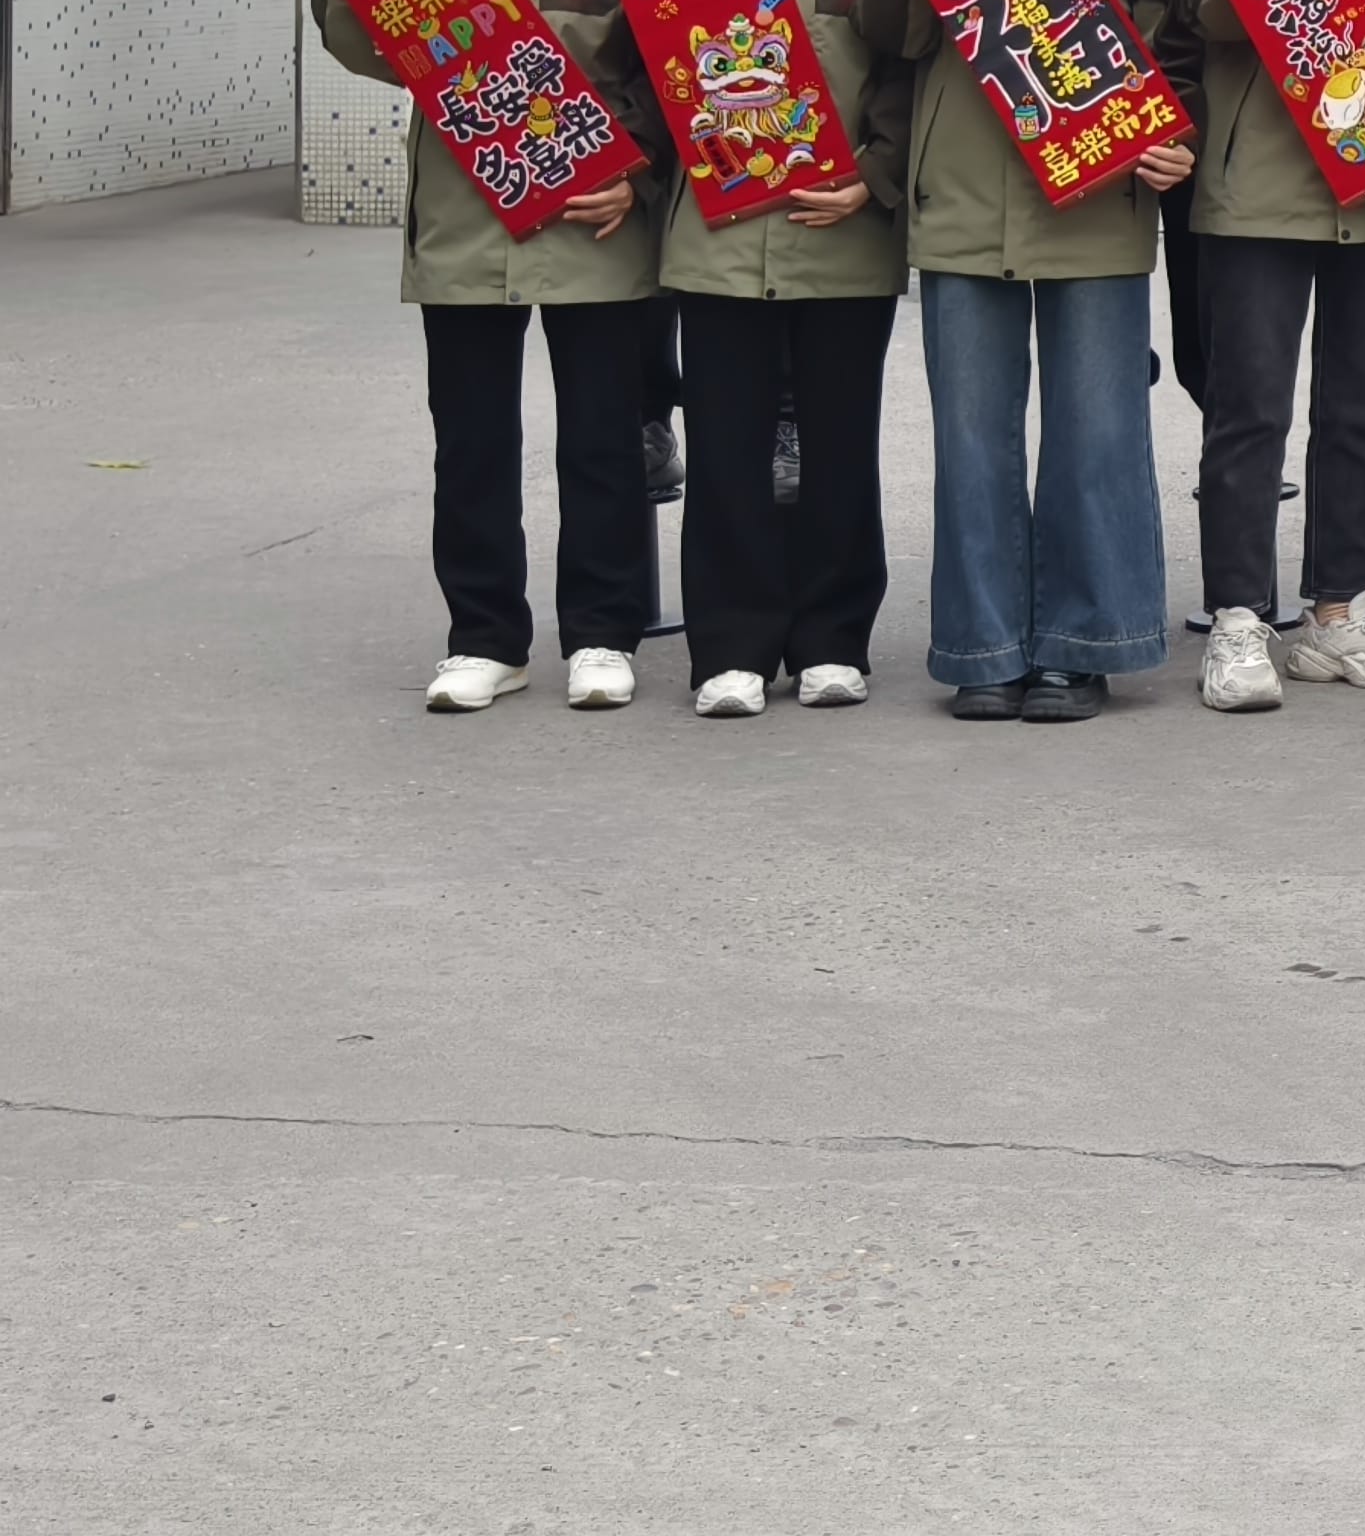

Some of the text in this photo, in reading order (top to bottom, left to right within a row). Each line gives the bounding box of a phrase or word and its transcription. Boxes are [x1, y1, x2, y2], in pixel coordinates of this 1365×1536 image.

[473, 92, 615, 207] 多喜樂
[1038, 94, 1177, 188] 喜樂常在
